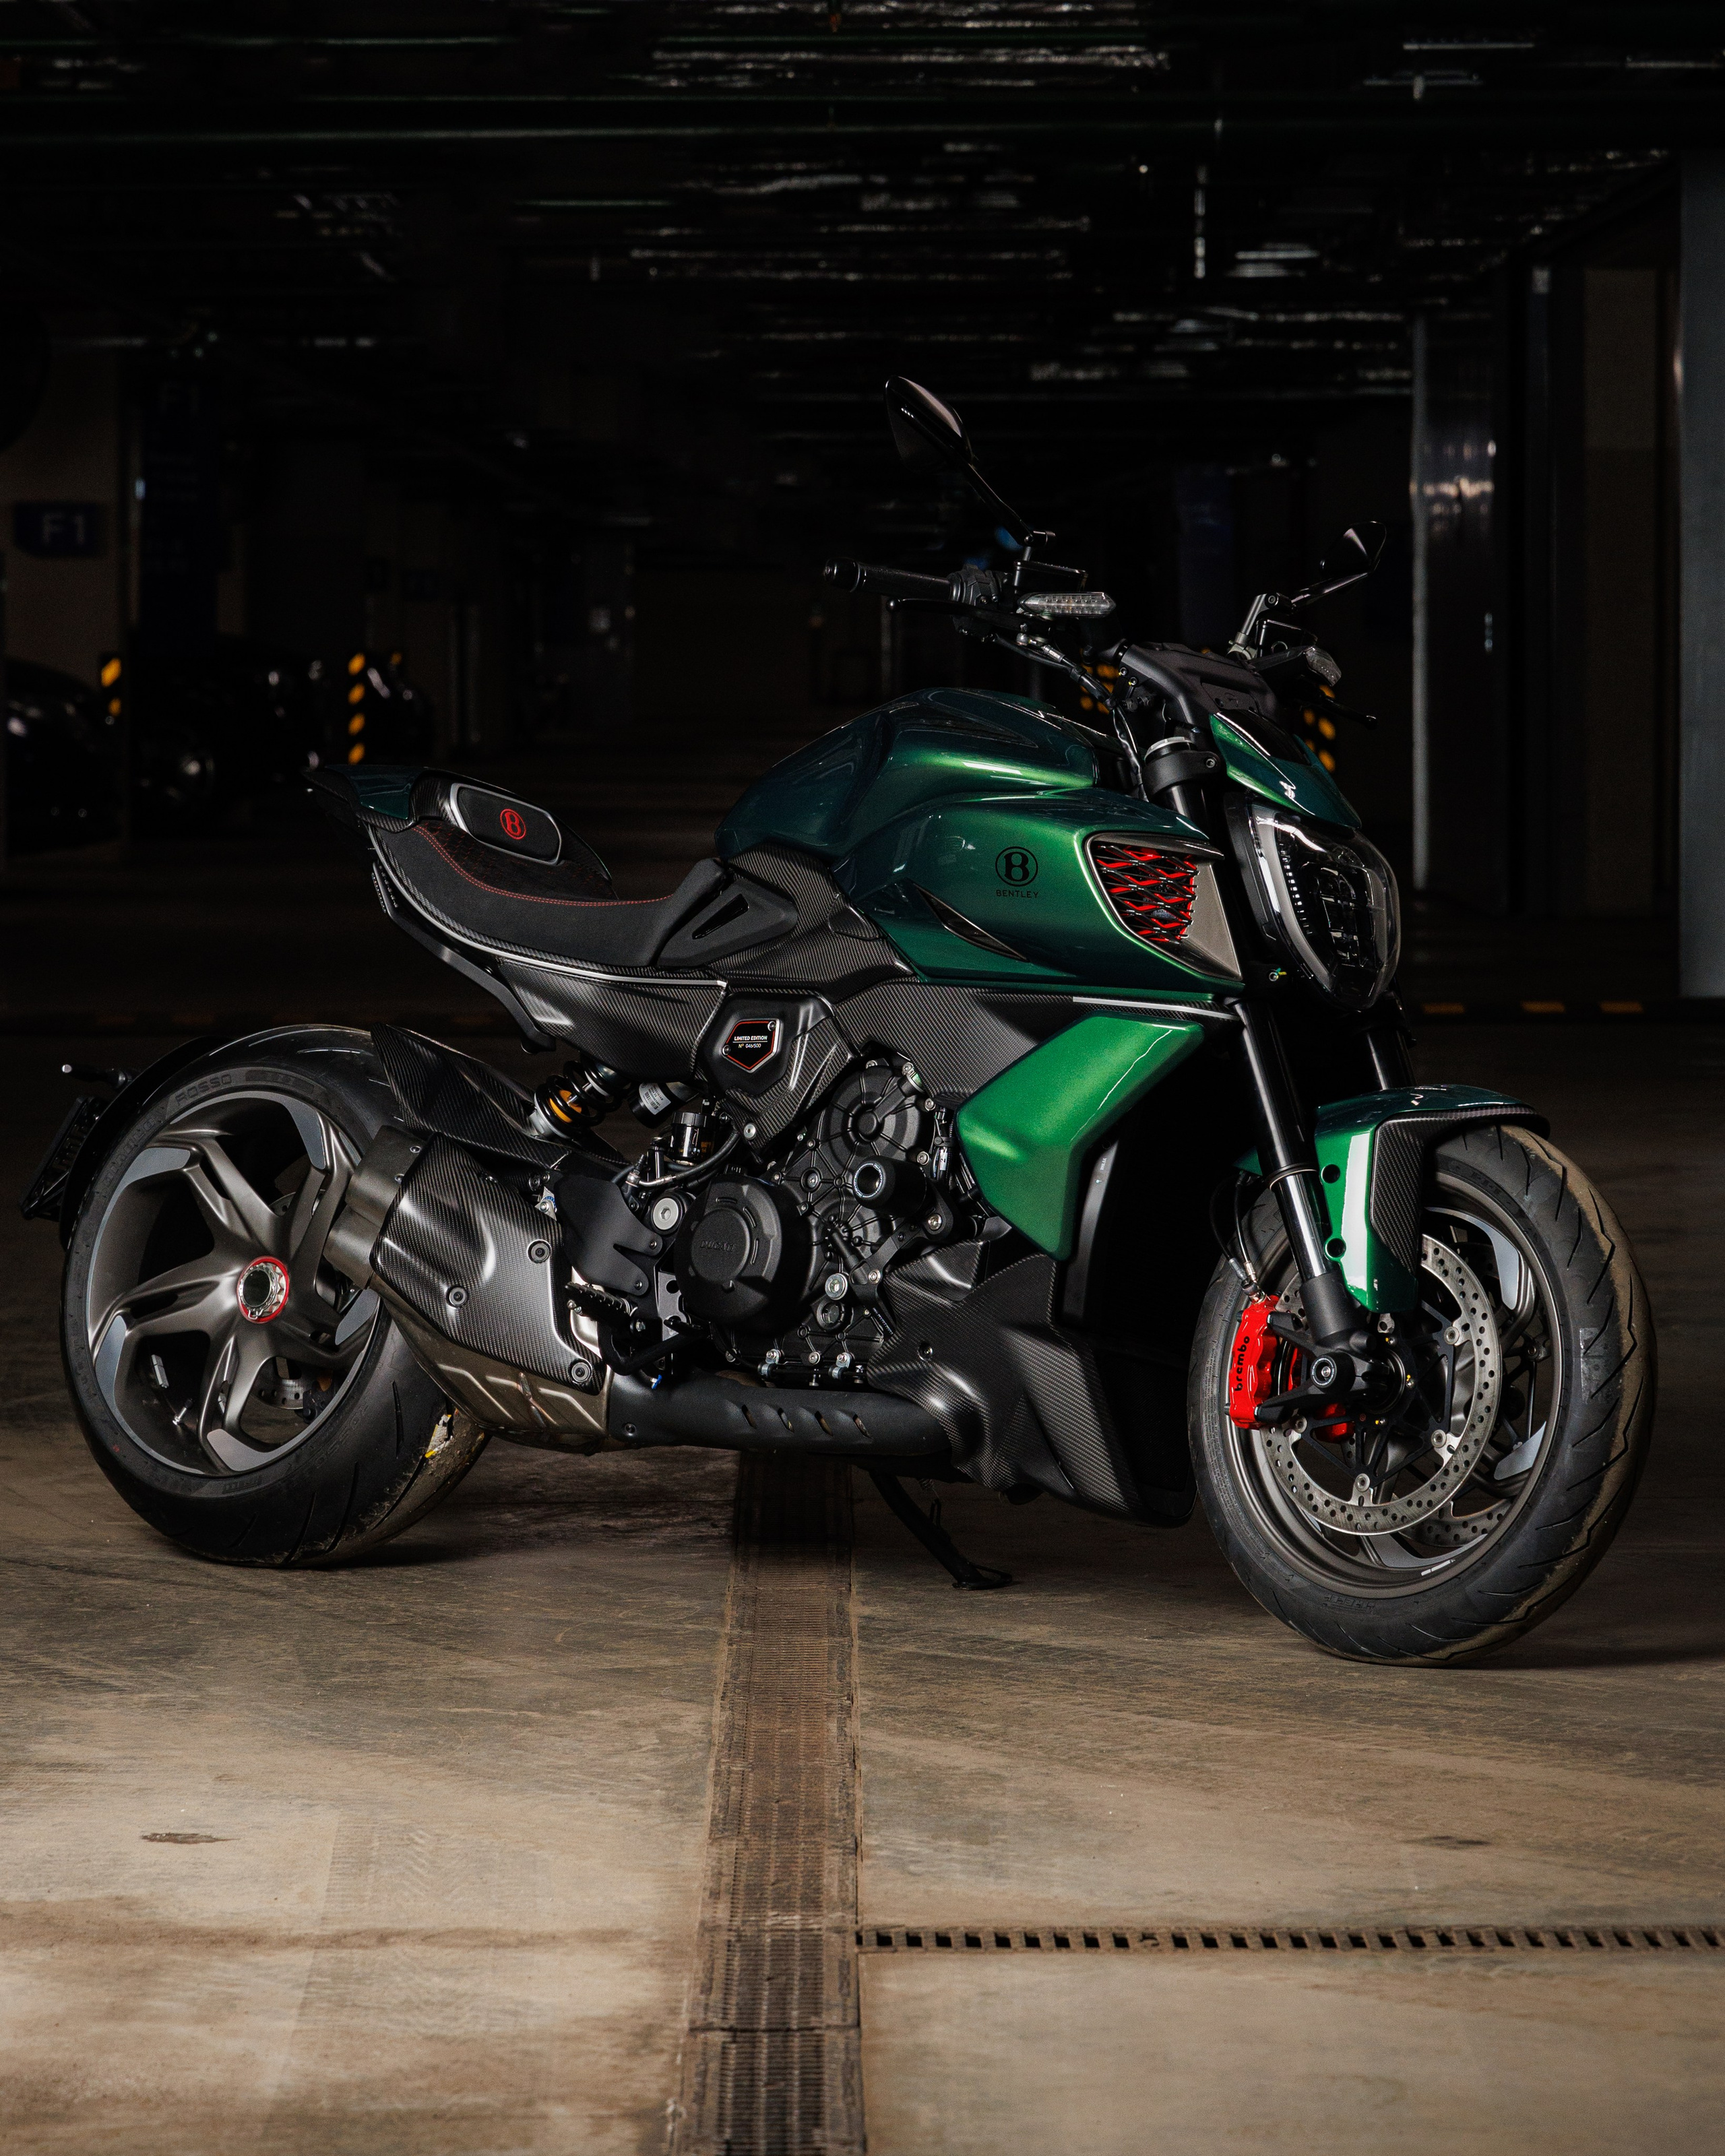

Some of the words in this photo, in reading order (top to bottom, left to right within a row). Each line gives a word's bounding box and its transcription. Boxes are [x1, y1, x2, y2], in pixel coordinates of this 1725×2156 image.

[42, 512, 86, 545] F1
[996, 889, 1039, 899] BENTLEY
[175, 1073, 232, 1106] ROSSO
[700, 1240, 736, 1252] DUCATI
[1234, 1336, 1250, 1391] brembo
